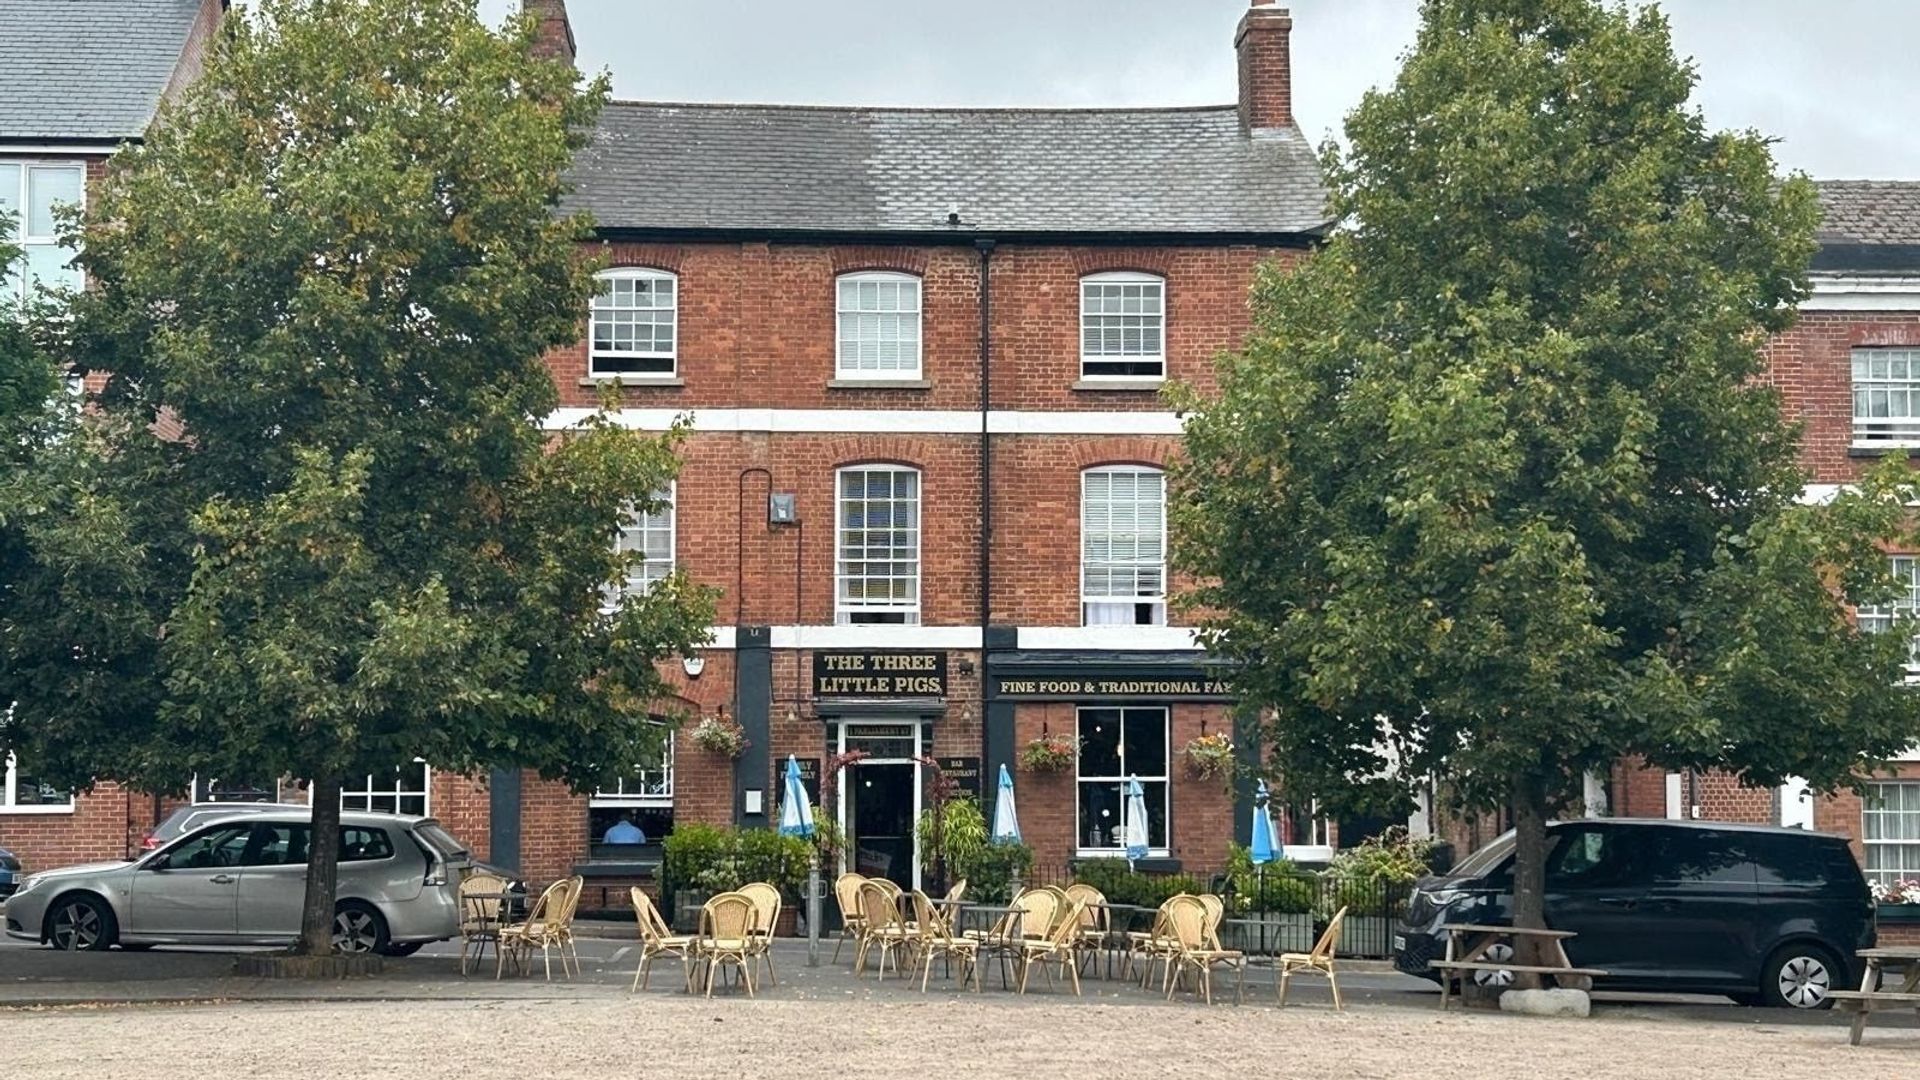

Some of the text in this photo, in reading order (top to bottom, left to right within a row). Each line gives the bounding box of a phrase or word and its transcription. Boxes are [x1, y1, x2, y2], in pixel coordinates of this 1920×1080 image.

[824, 655, 936, 671] THE THREE
[819, 677, 941, 693] LITTLE PIGS
[1000, 681, 1036, 693] FINE
[1039, 681, 1080, 693] FOOD
[1084, 681, 1095, 693] &
[1098, 681, 1200, 693] TRADITIONAL
